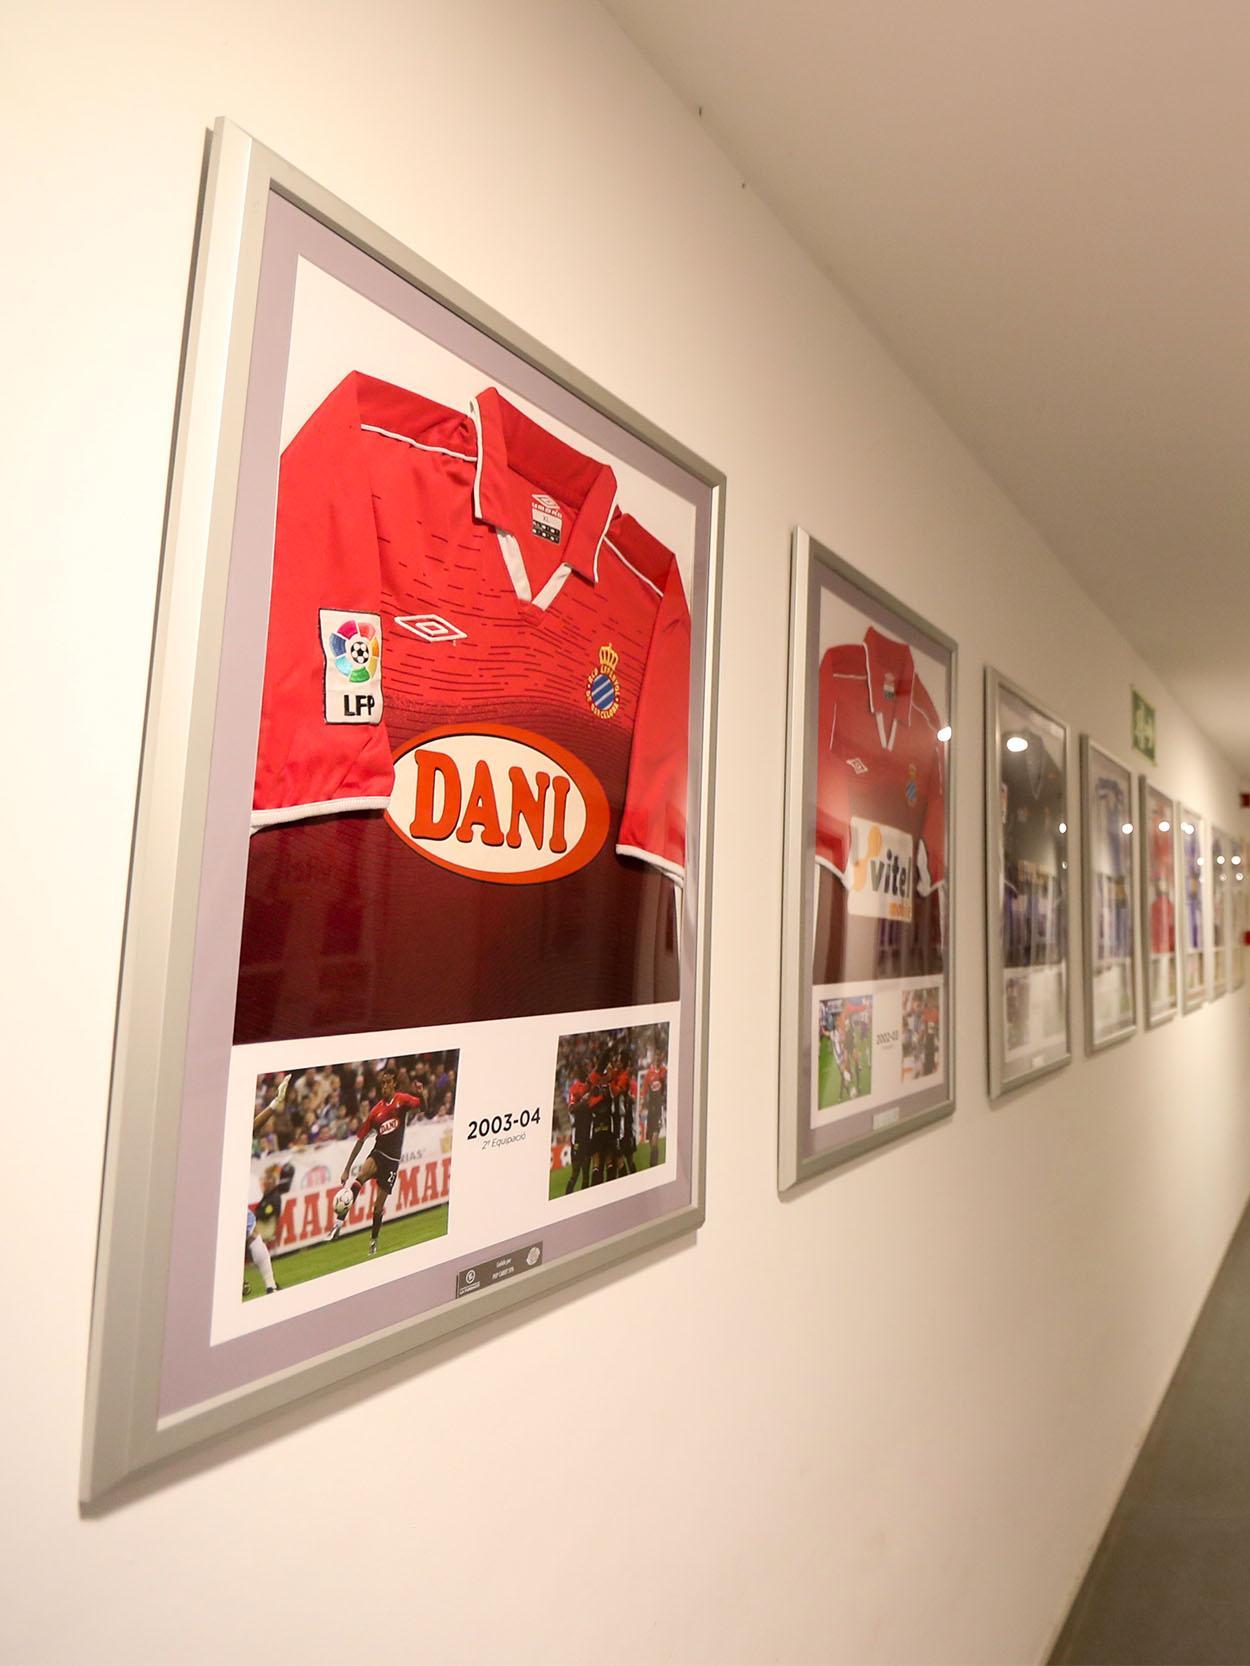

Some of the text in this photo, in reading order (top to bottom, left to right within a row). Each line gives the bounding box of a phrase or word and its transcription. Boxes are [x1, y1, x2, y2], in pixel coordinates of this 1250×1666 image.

[343, 694, 375, 717] LFP
[409, 749, 571, 854] DANI
[467, 1107, 541, 1140] 2003-04
